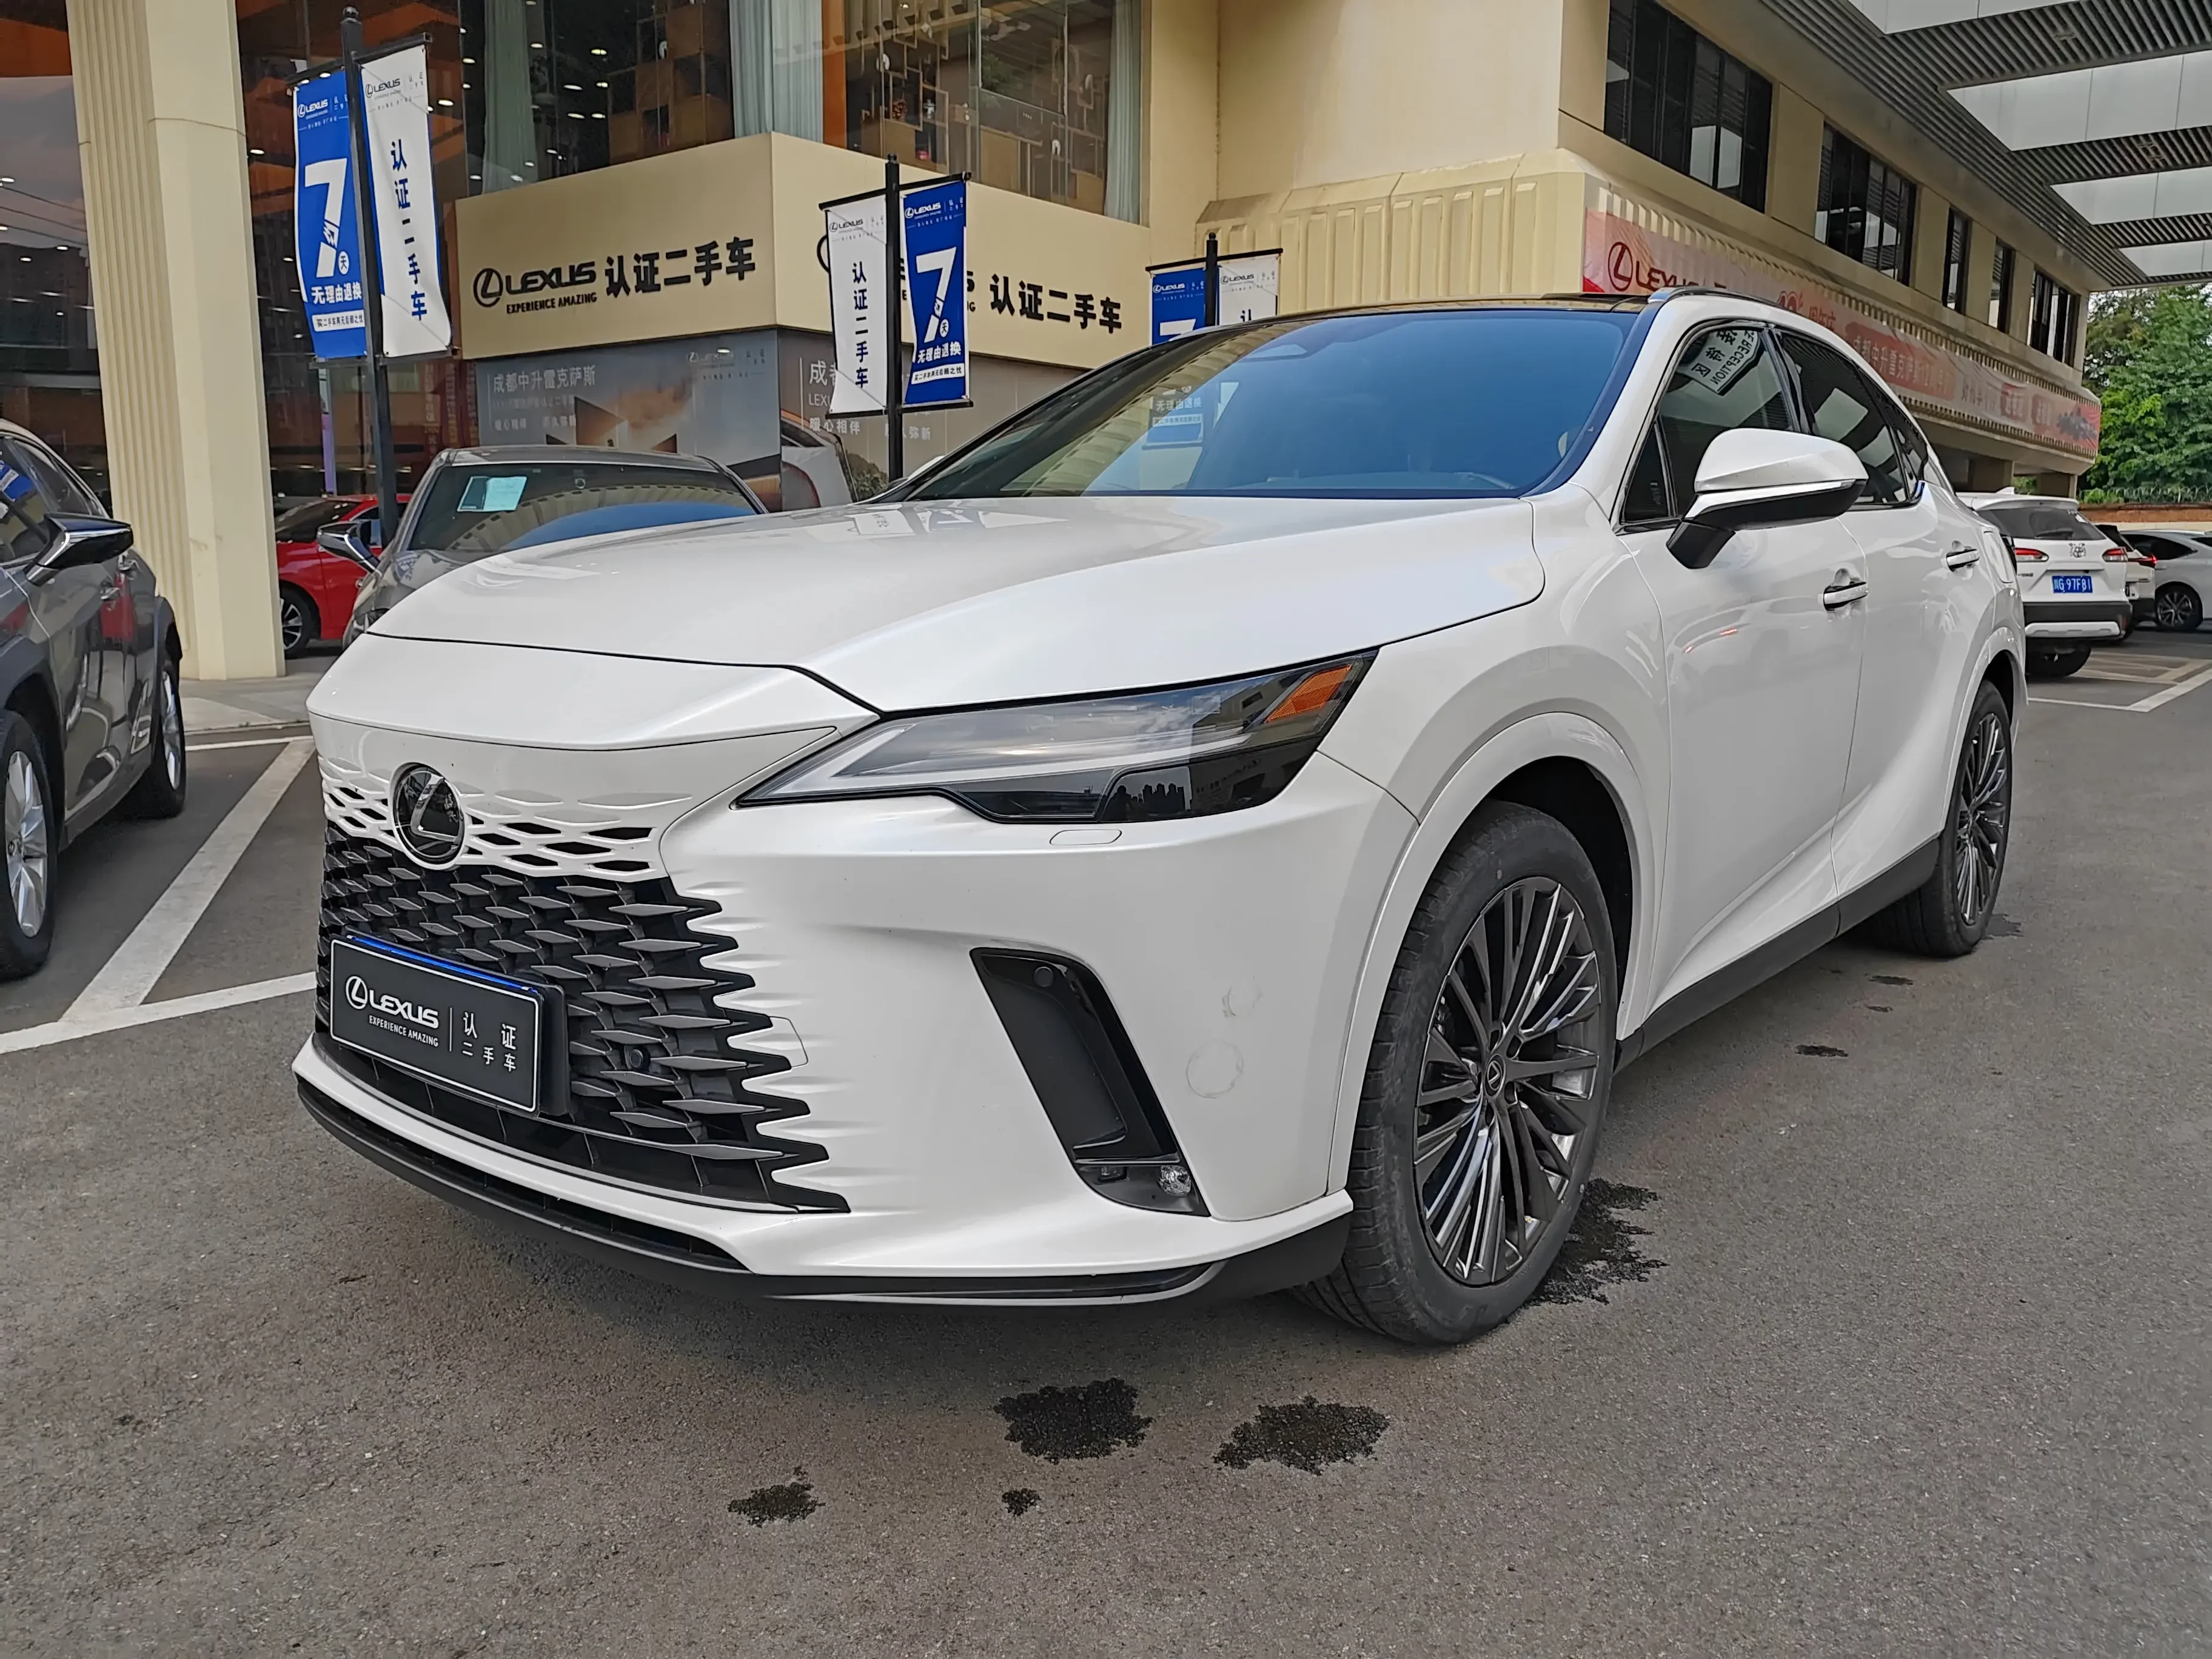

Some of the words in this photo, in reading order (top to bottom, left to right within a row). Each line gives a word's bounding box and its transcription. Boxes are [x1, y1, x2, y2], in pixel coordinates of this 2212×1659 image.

[391, 139, 427, 321] 认证二手车
[505, 261, 597, 295] LEXUS
[605, 236, 756, 298] 认证二手车
[311, 281, 362, 305] 无理由退换
[506, 298, 555, 314] EXPERIENCE
[558, 292, 597, 307] AMAZING
[990, 273, 1122, 334] 认证二手车
[852, 261, 869, 389] 认证二手车
[917, 341, 962, 364] 无理由退换
[369, 989, 439, 1029] LEXUS
[369, 1014, 407, 1037] EXPERIENCE
[407, 1029, 439, 1047] AMAZING
